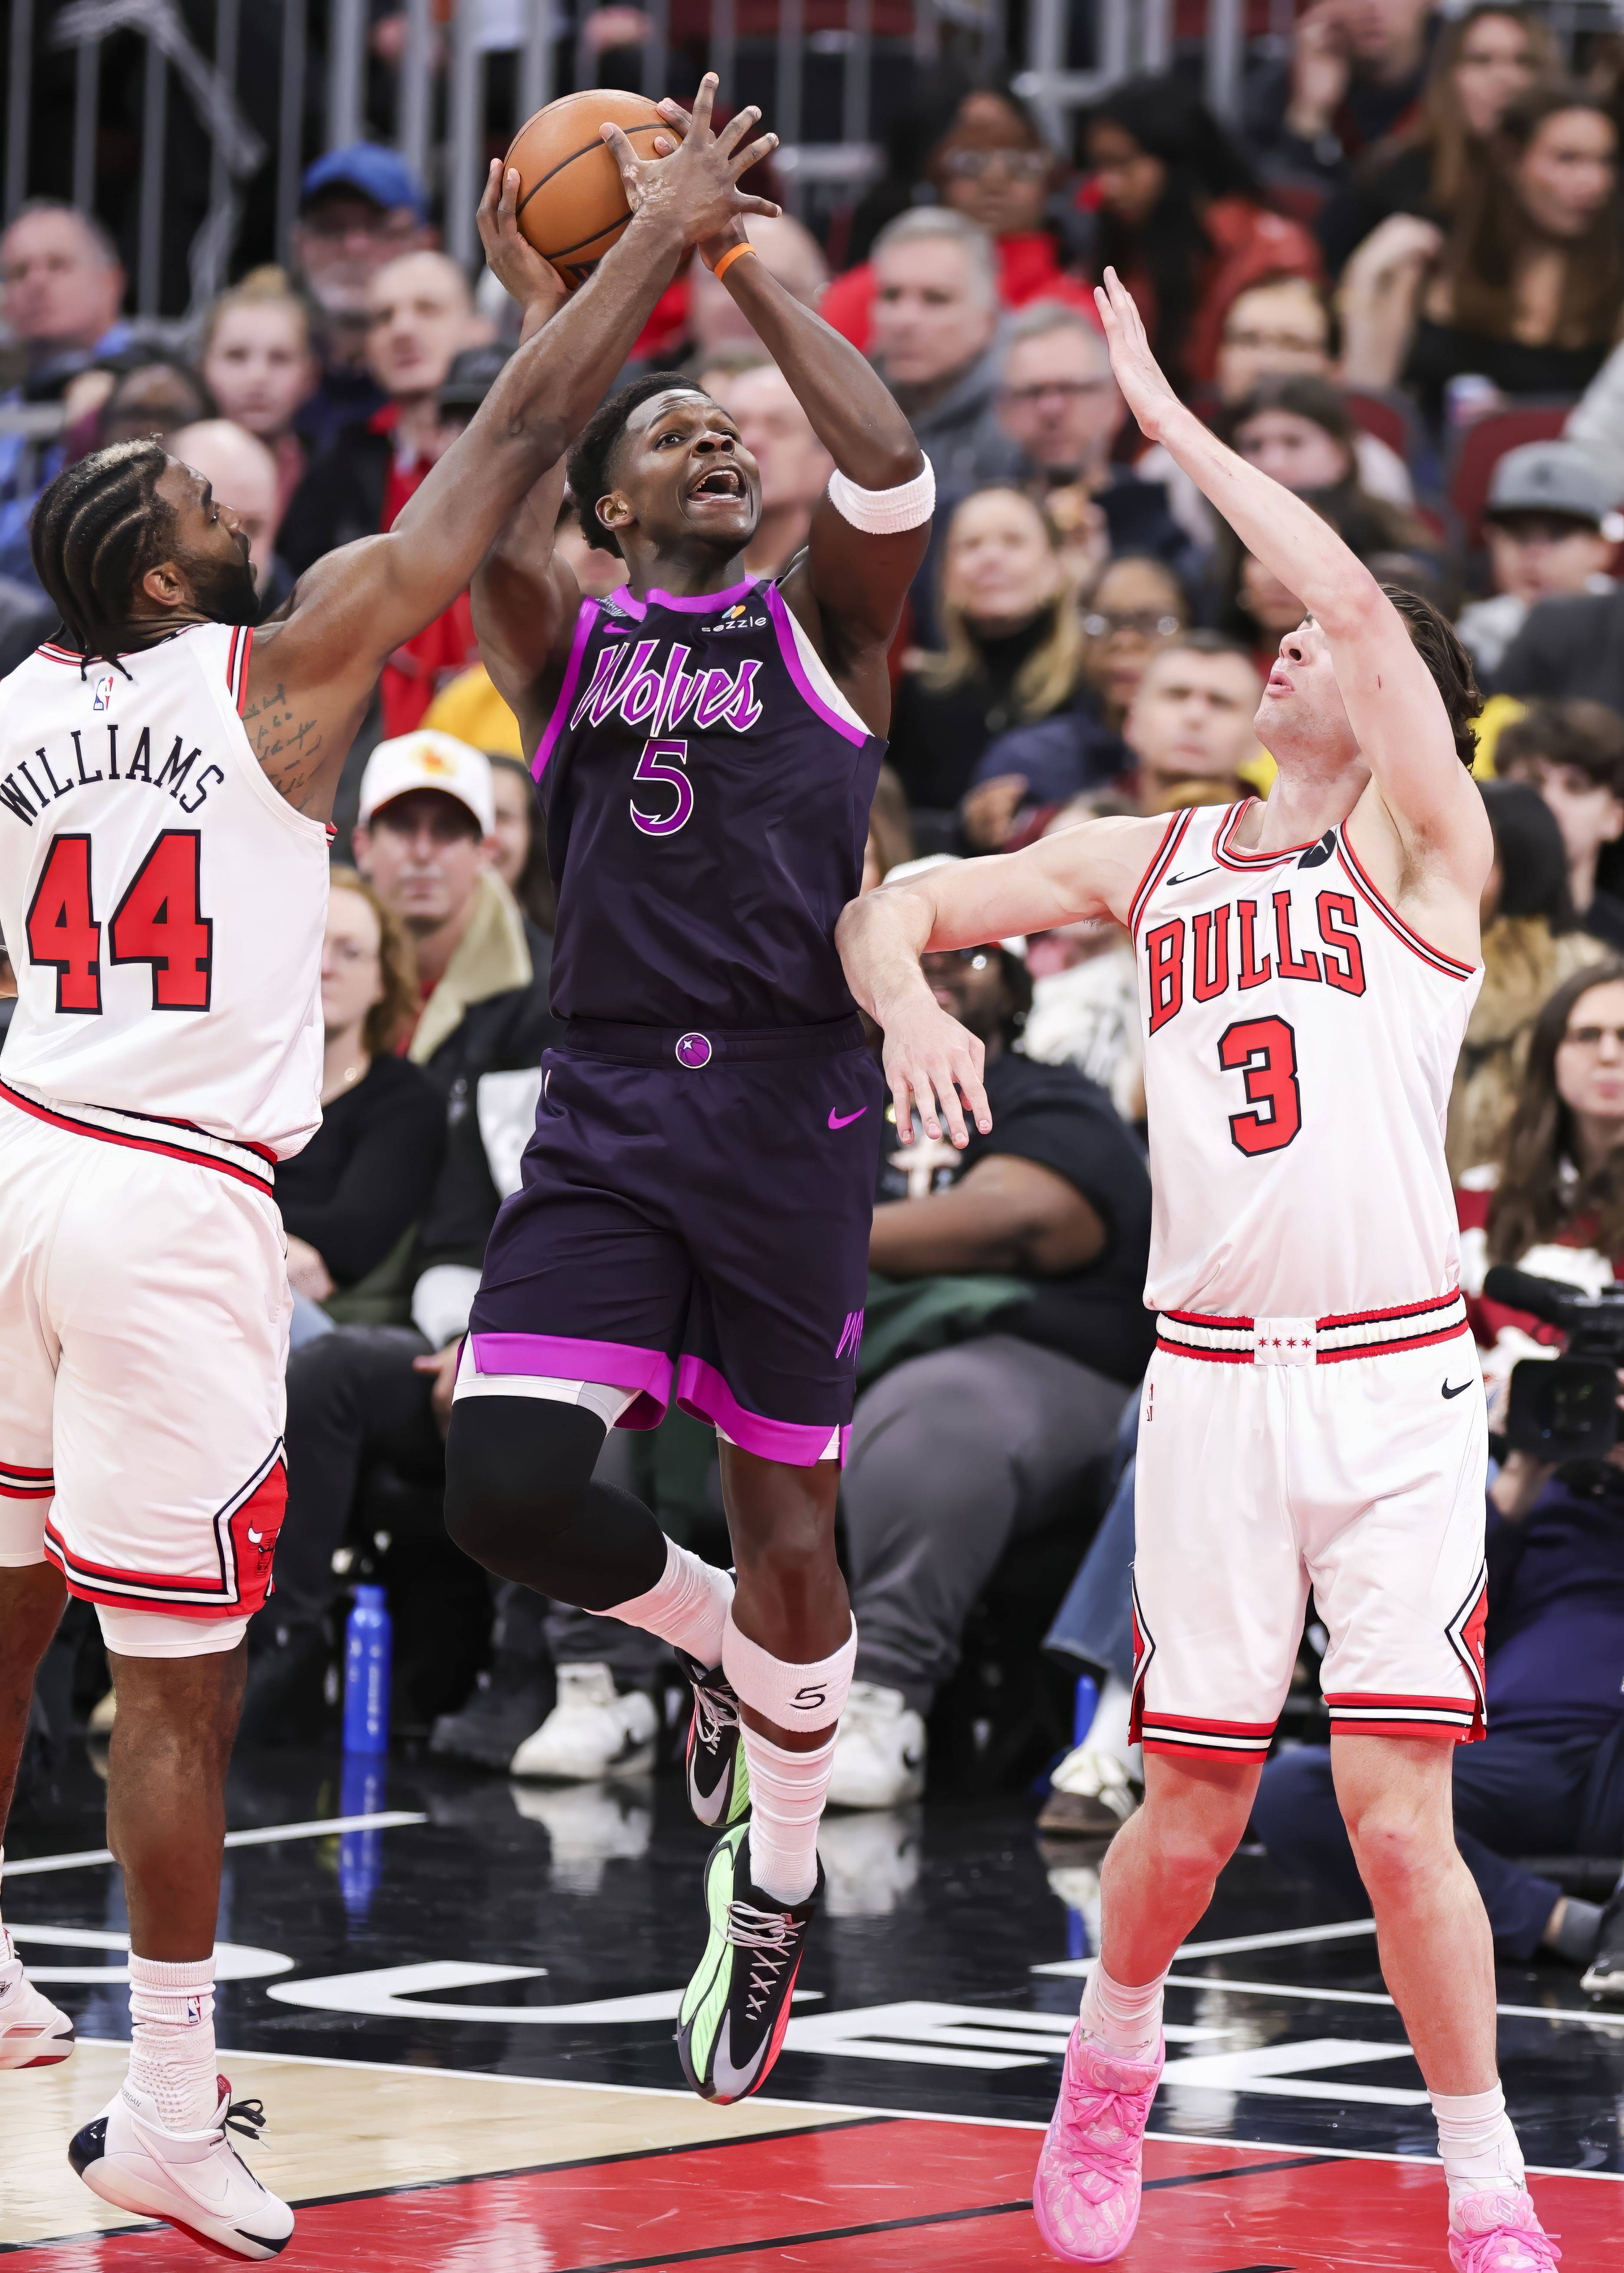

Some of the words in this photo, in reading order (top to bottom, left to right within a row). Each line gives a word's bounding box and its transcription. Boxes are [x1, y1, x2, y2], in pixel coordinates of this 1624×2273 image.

[570, 639, 763, 737] Wolves
[0, 724, 224, 826] WILLIAMS
[630, 739, 694, 836] 5
[25, 829, 213, 1015] 44
[1146, 889, 1367, 1038] BULLS
[1217, 1014, 1302, 1158] 3
[786, 1683, 827, 1710] 5
